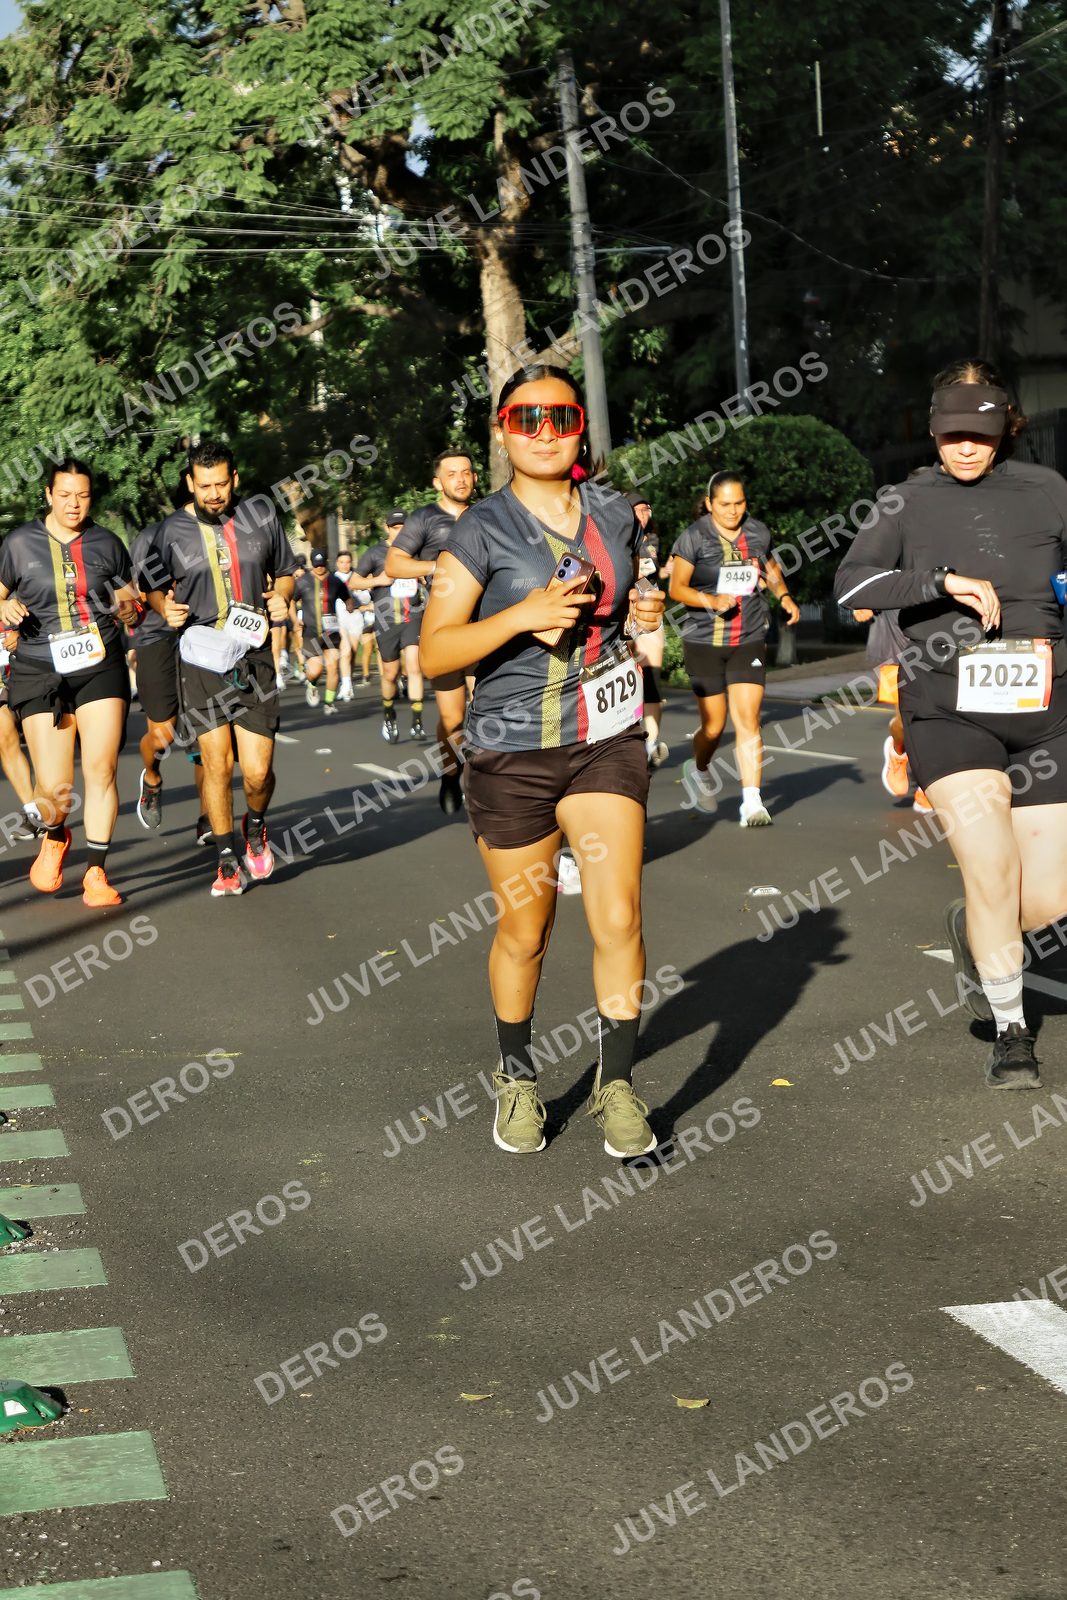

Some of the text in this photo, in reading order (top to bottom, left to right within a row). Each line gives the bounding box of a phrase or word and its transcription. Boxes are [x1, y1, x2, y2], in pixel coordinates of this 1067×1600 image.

[726, 571, 752, 583] 9449
[233, 614, 262, 632] 6029
[60, 639, 94, 658] 6026
[965, 664, 1039, 687] 12022
[596, 670, 637, 713] 8729
